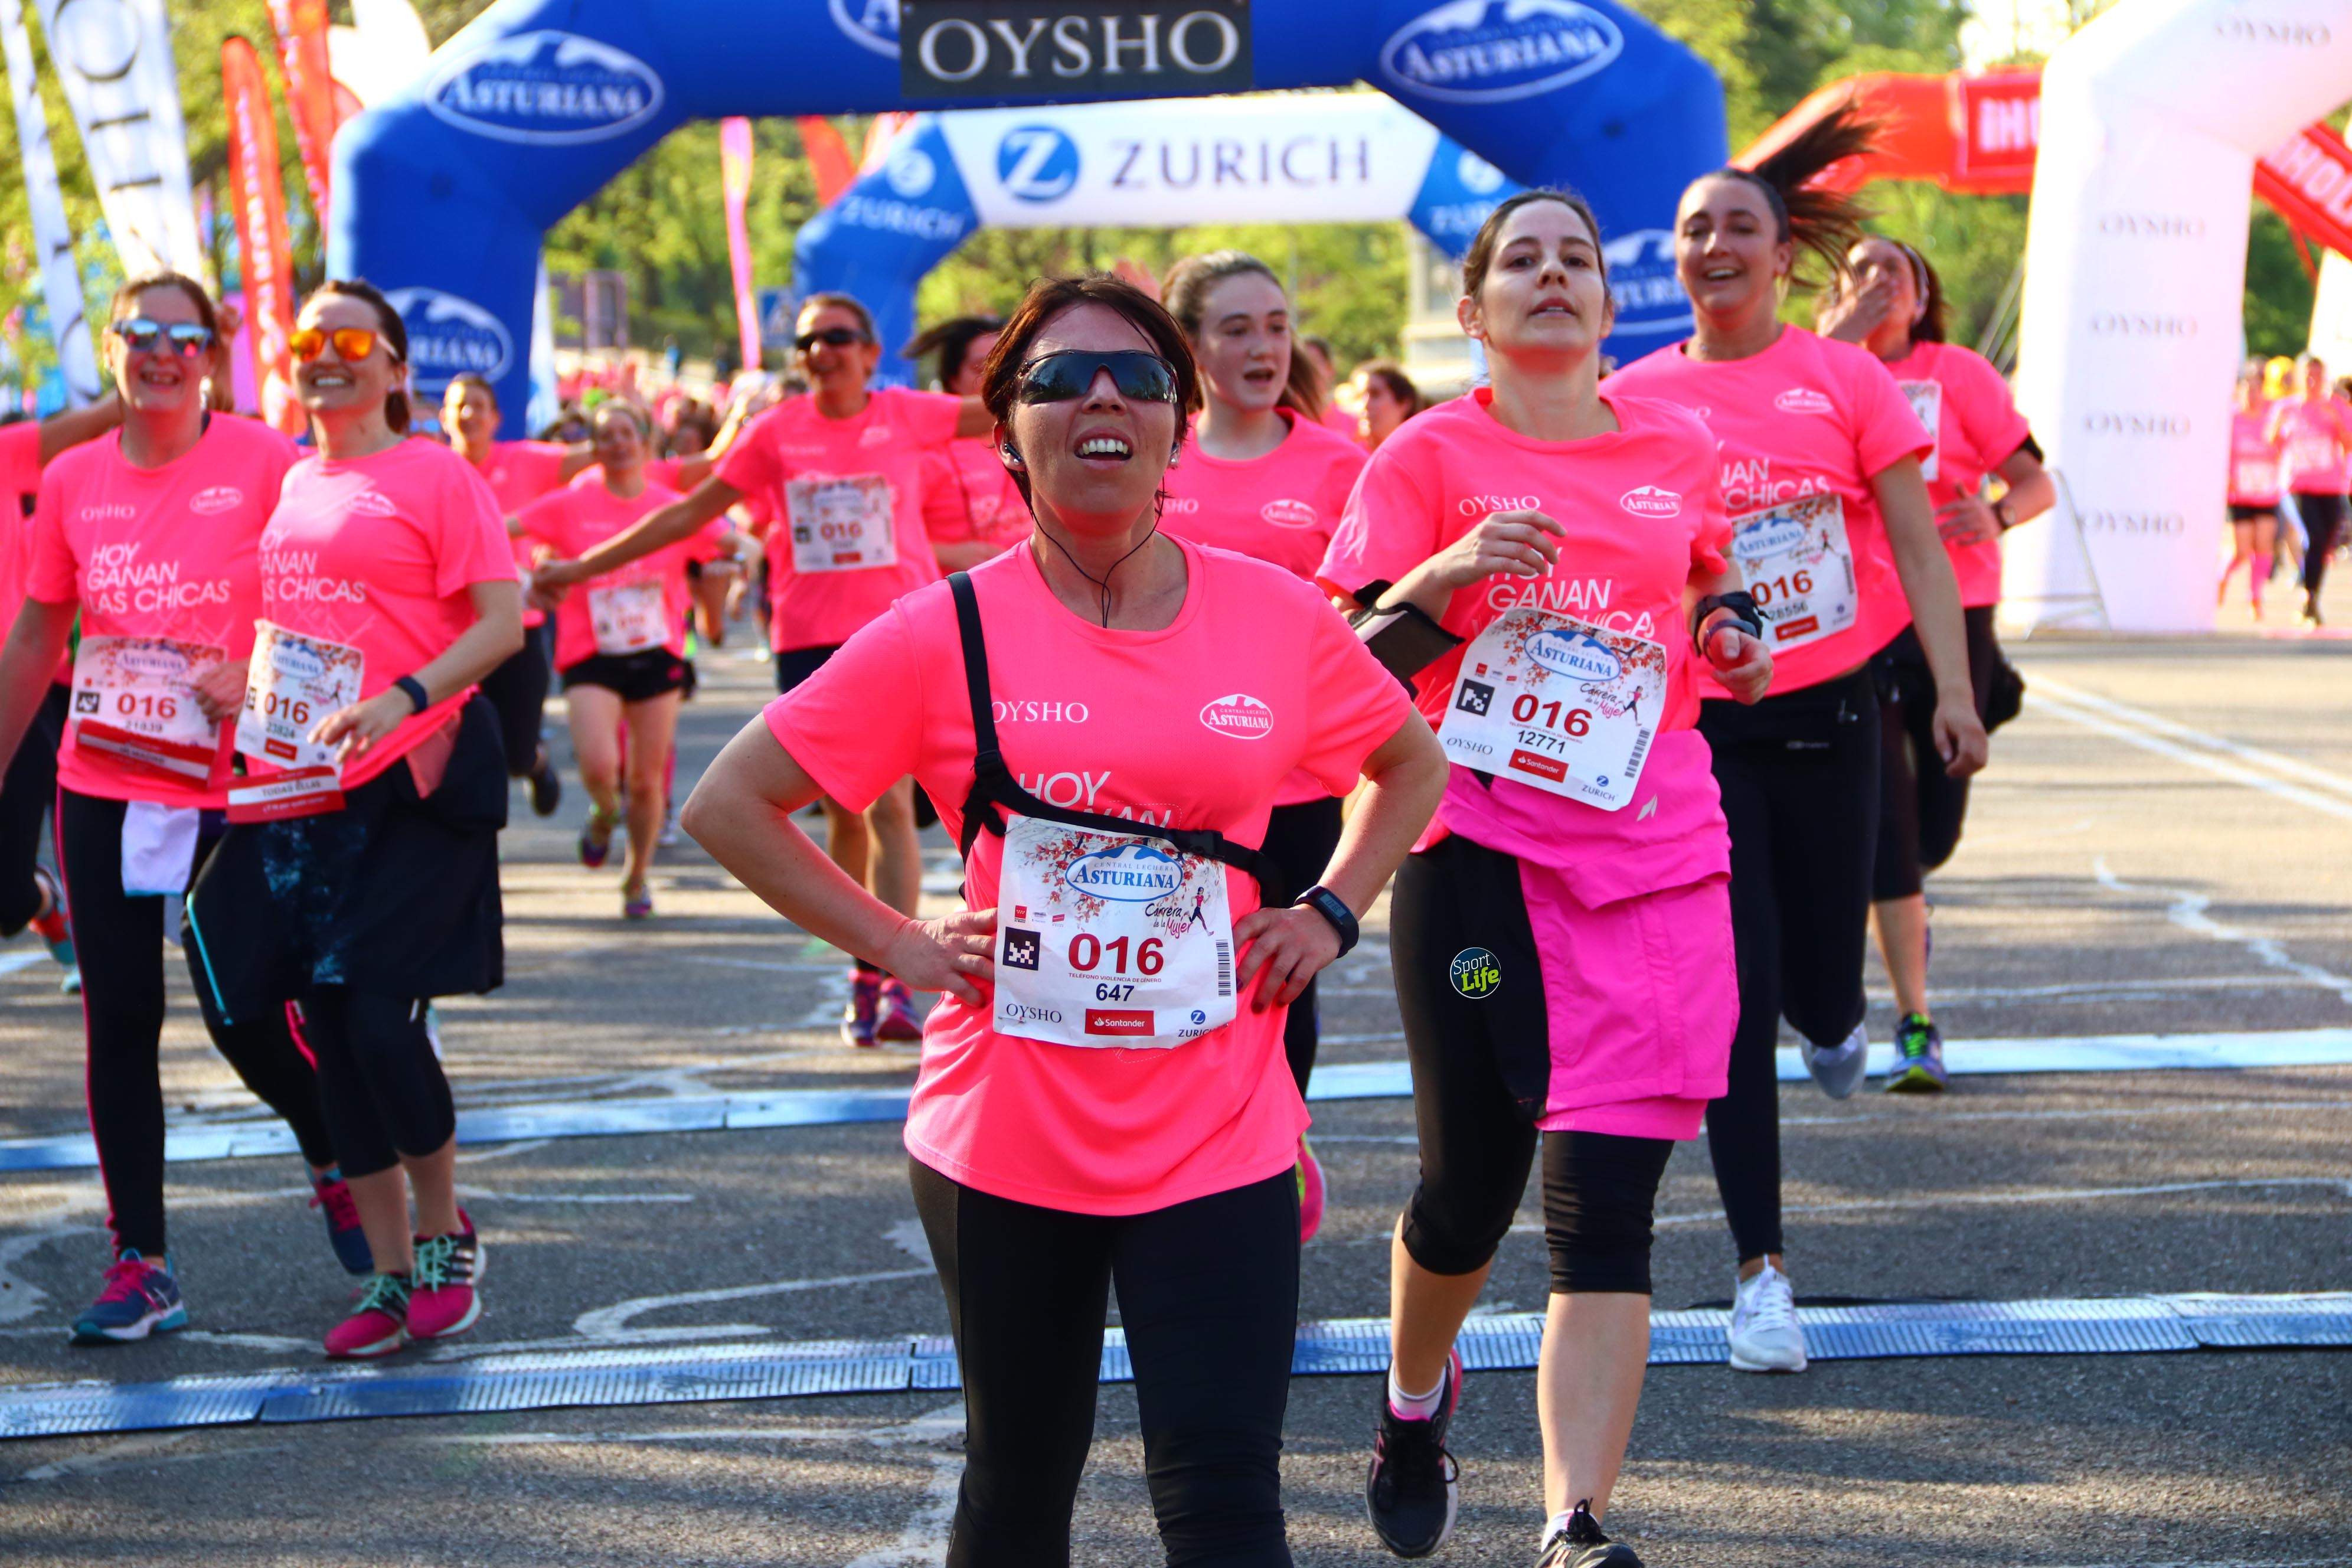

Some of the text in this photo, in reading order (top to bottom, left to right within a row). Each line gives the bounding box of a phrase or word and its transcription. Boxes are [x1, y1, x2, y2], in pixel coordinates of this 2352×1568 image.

[918, 11, 1240, 82] OYSHO
[1403, 25, 1608, 83] ASTURIANA
[439, 70, 643, 117] ASTURIANA
[1110, 136, 1370, 189] ZURICH
[2098, 213, 2207, 239] OYSHO
[2090, 313, 2199, 338] OYSHO
[2084, 413, 2191, 438] OYSHO
[1459, 495, 1541, 517] OYSHO
[89, 541, 141, 568] HOY
[87, 559, 179, 592] GANAN
[1751, 569, 1813, 607] 016
[133, 579, 231, 613] CHICAS
[279, 576, 367, 604] CHICAS
[1487, 579, 1612, 612] GANAN
[1530, 638, 1612, 677] ASTURIANA
[117, 693, 177, 720] 016
[264, 692, 311, 725] 016
[992, 701, 1089, 723] OYSHO
[1208, 709, 1269, 729] ASTURIANA
[1511, 693, 1593, 737] 016
[1447, 737, 1494, 756] OYSHO
[1518, 730, 1566, 754] 12771
[1526, 757, 1560, 775] Santander
[1020, 771, 1112, 808] HOY
[1582, 784, 1616, 802] ZURICH
[1073, 864, 1175, 888] ASTURIANA
[1094, 861, 1133, 870] CENTRAL
[1145, 903, 1183, 919] Carrera
[1164, 916, 1194, 939] Mujer
[1068, 933, 1164, 976] 016
[1453, 953, 1491, 975] Sport
[1461, 966, 1500, 992] Life
[1096, 983, 1135, 1002] 647
[1005, 1003, 1062, 1023] OYSHO
[1105, 1018, 1145, 1028] Santander
[1178, 1028, 1214, 1037] ZURIC
